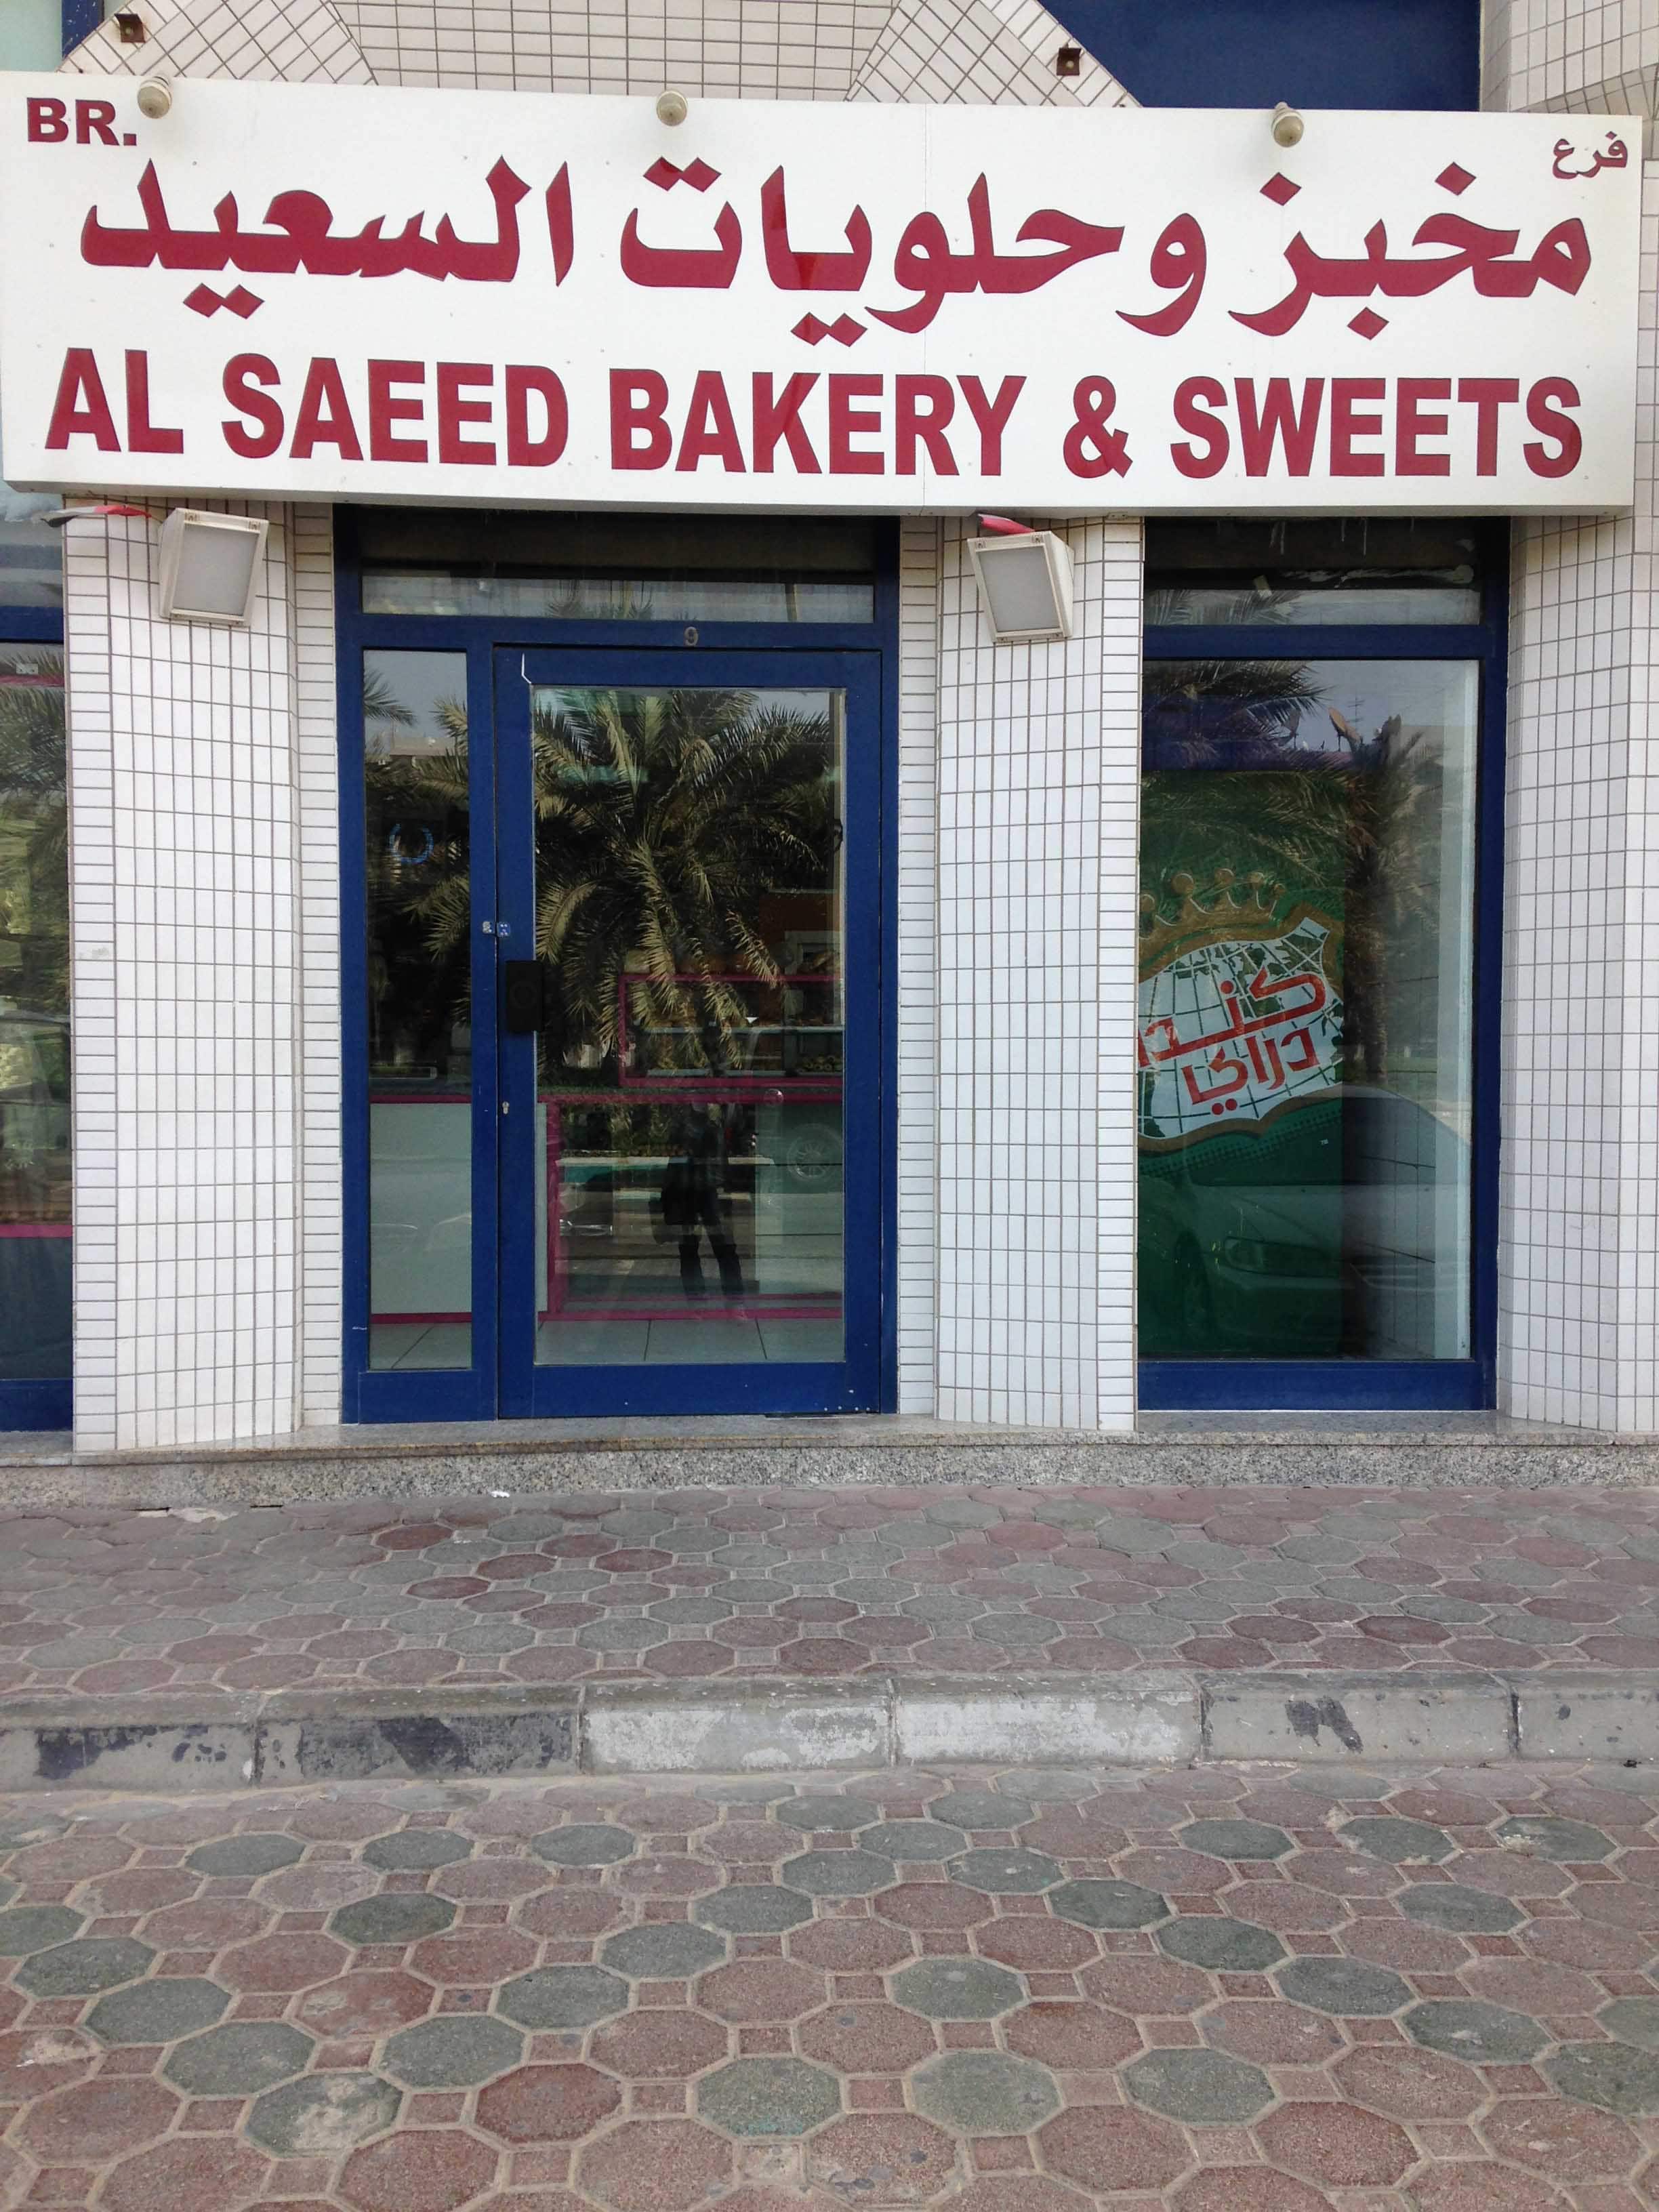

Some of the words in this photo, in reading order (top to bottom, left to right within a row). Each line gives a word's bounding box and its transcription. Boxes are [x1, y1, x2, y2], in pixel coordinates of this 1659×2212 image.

[28, 98, 138, 146] BR.
[1552, 130, 1629, 180] فرع
[81, 156, 574, 319] السعيد
[1228, 162, 1593, 340] مخبز
[45, 348, 184, 453] AL
[222, 353, 569, 467] SAEED
[610, 369, 1027, 476] BAKERY
[1063, 375, 1133, 478] &
[1170, 376, 1582, 478] SWEETS
